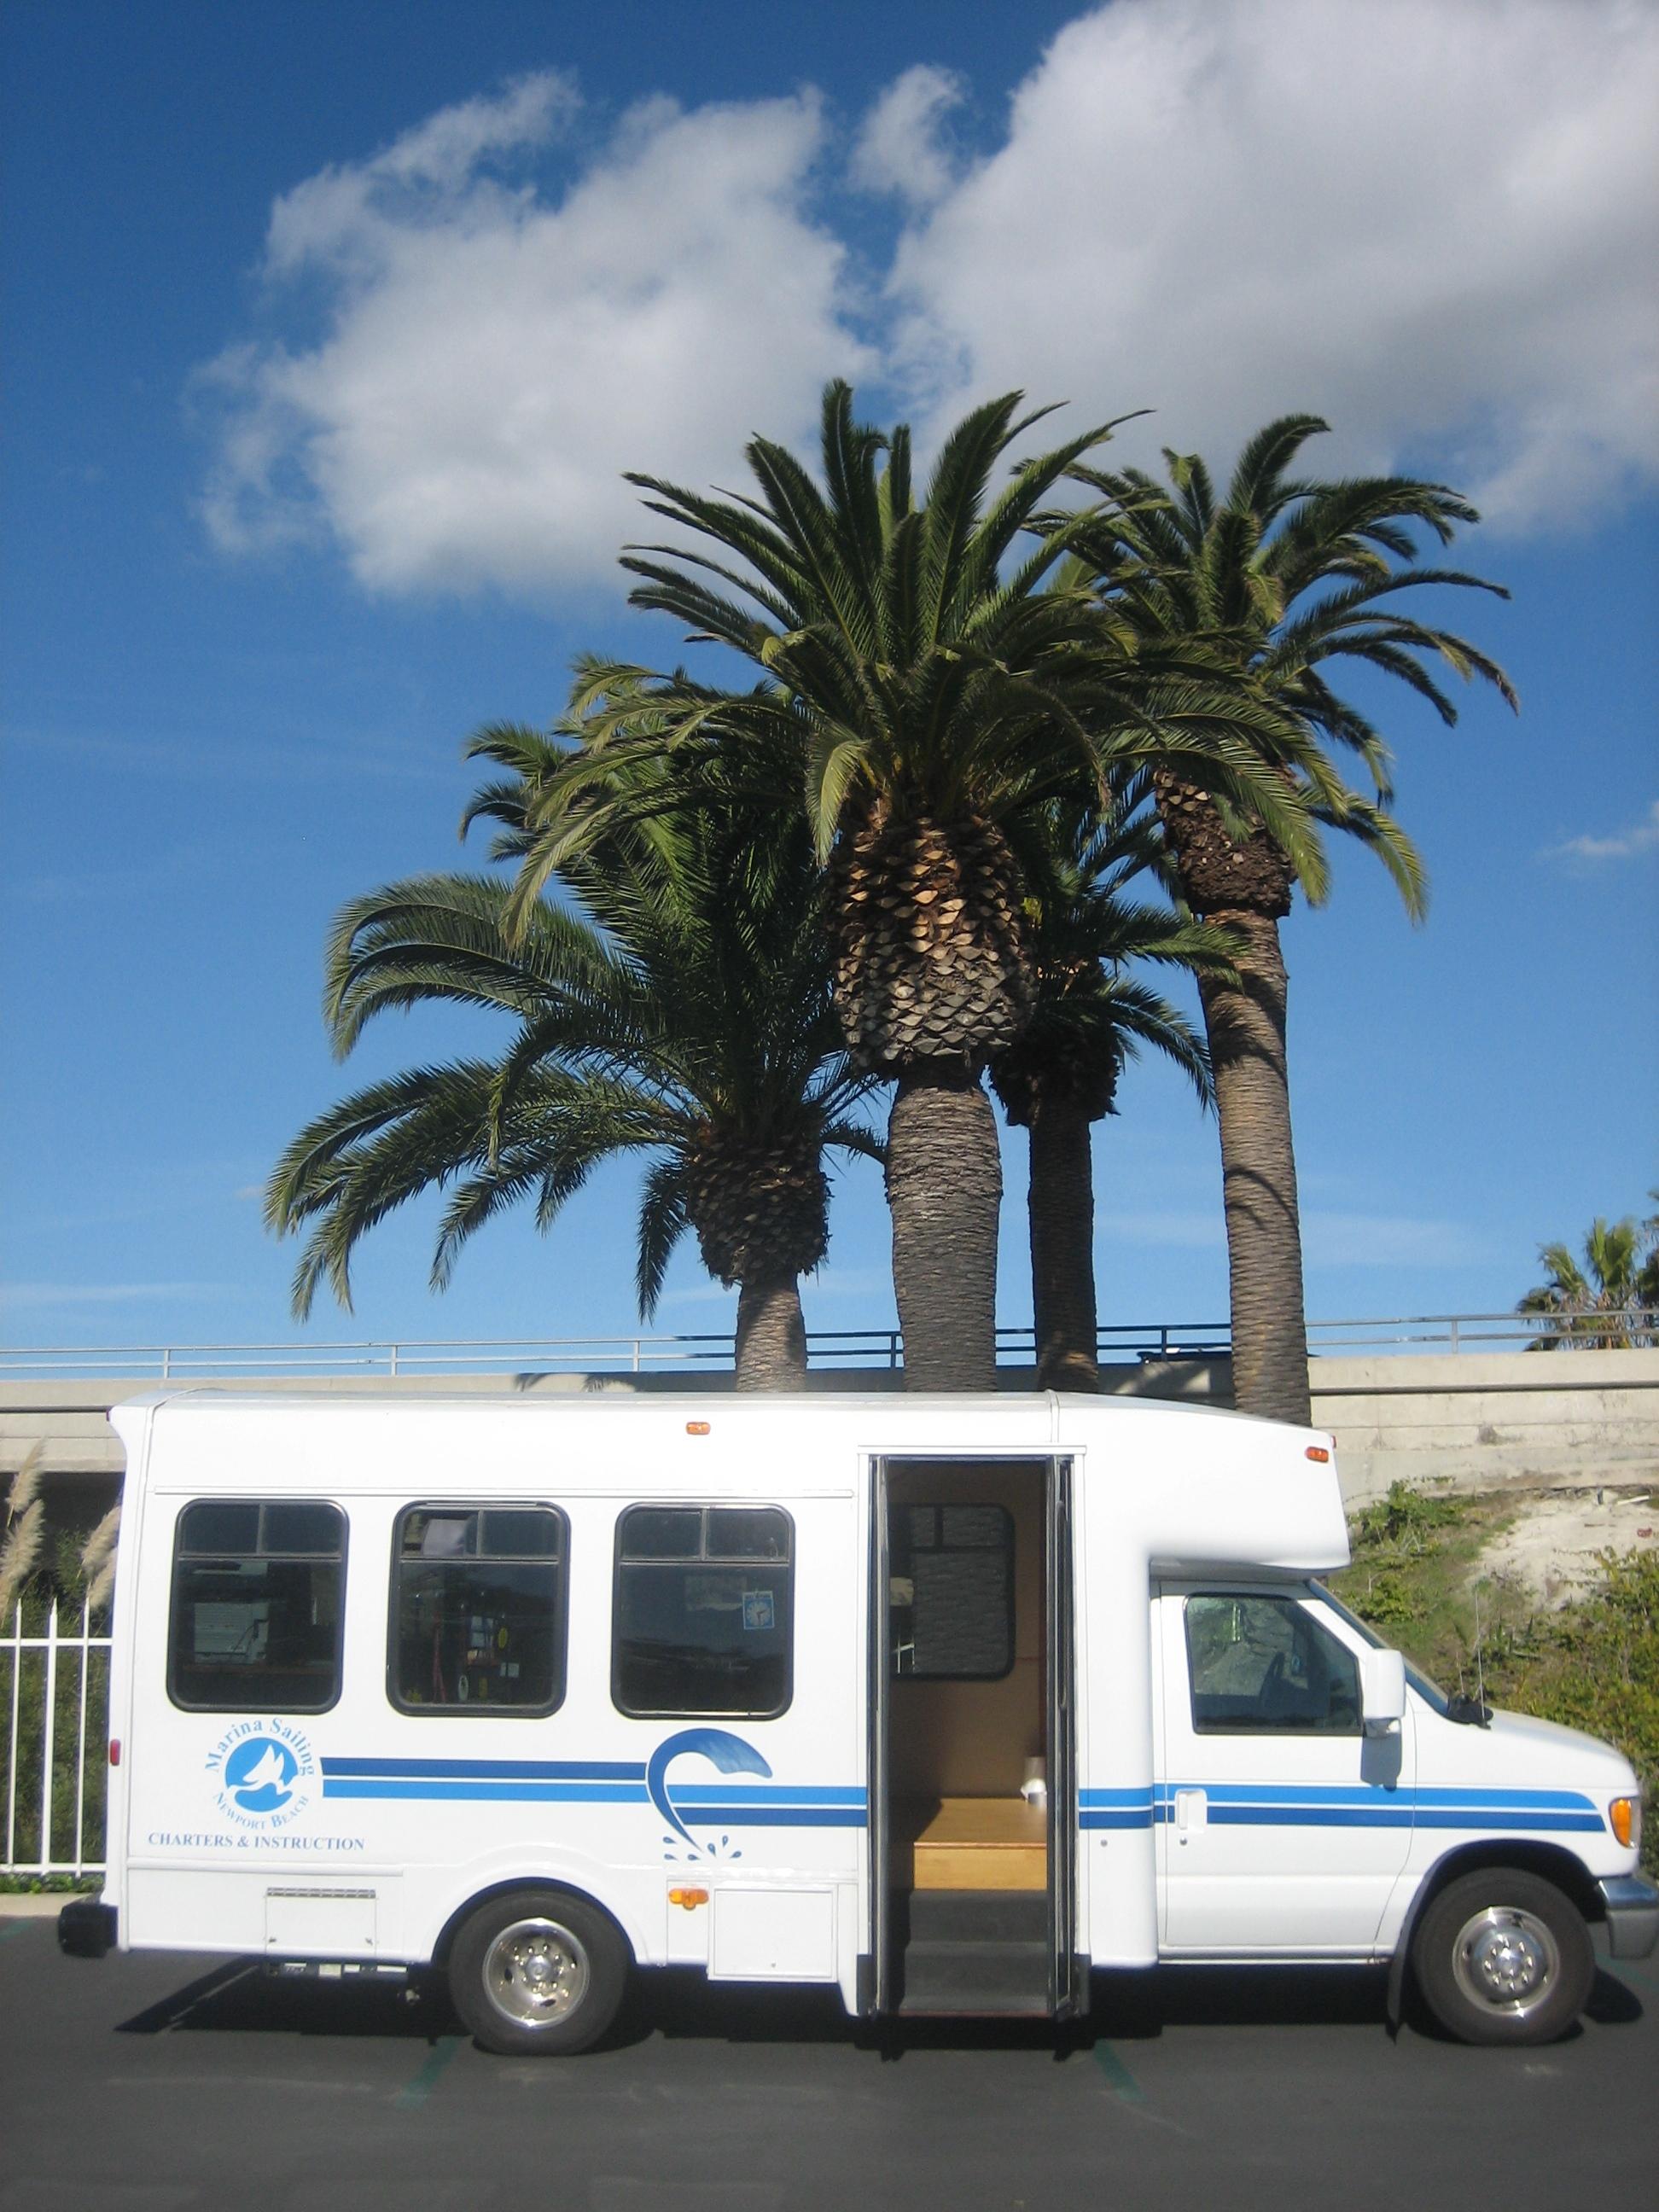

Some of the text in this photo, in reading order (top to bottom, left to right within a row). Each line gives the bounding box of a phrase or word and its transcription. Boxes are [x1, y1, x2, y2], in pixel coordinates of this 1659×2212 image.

[205, 1717, 315, 1776] Marina Sailing
[148, 1831, 365, 1851] CHARTERS & INSTRUCTION
